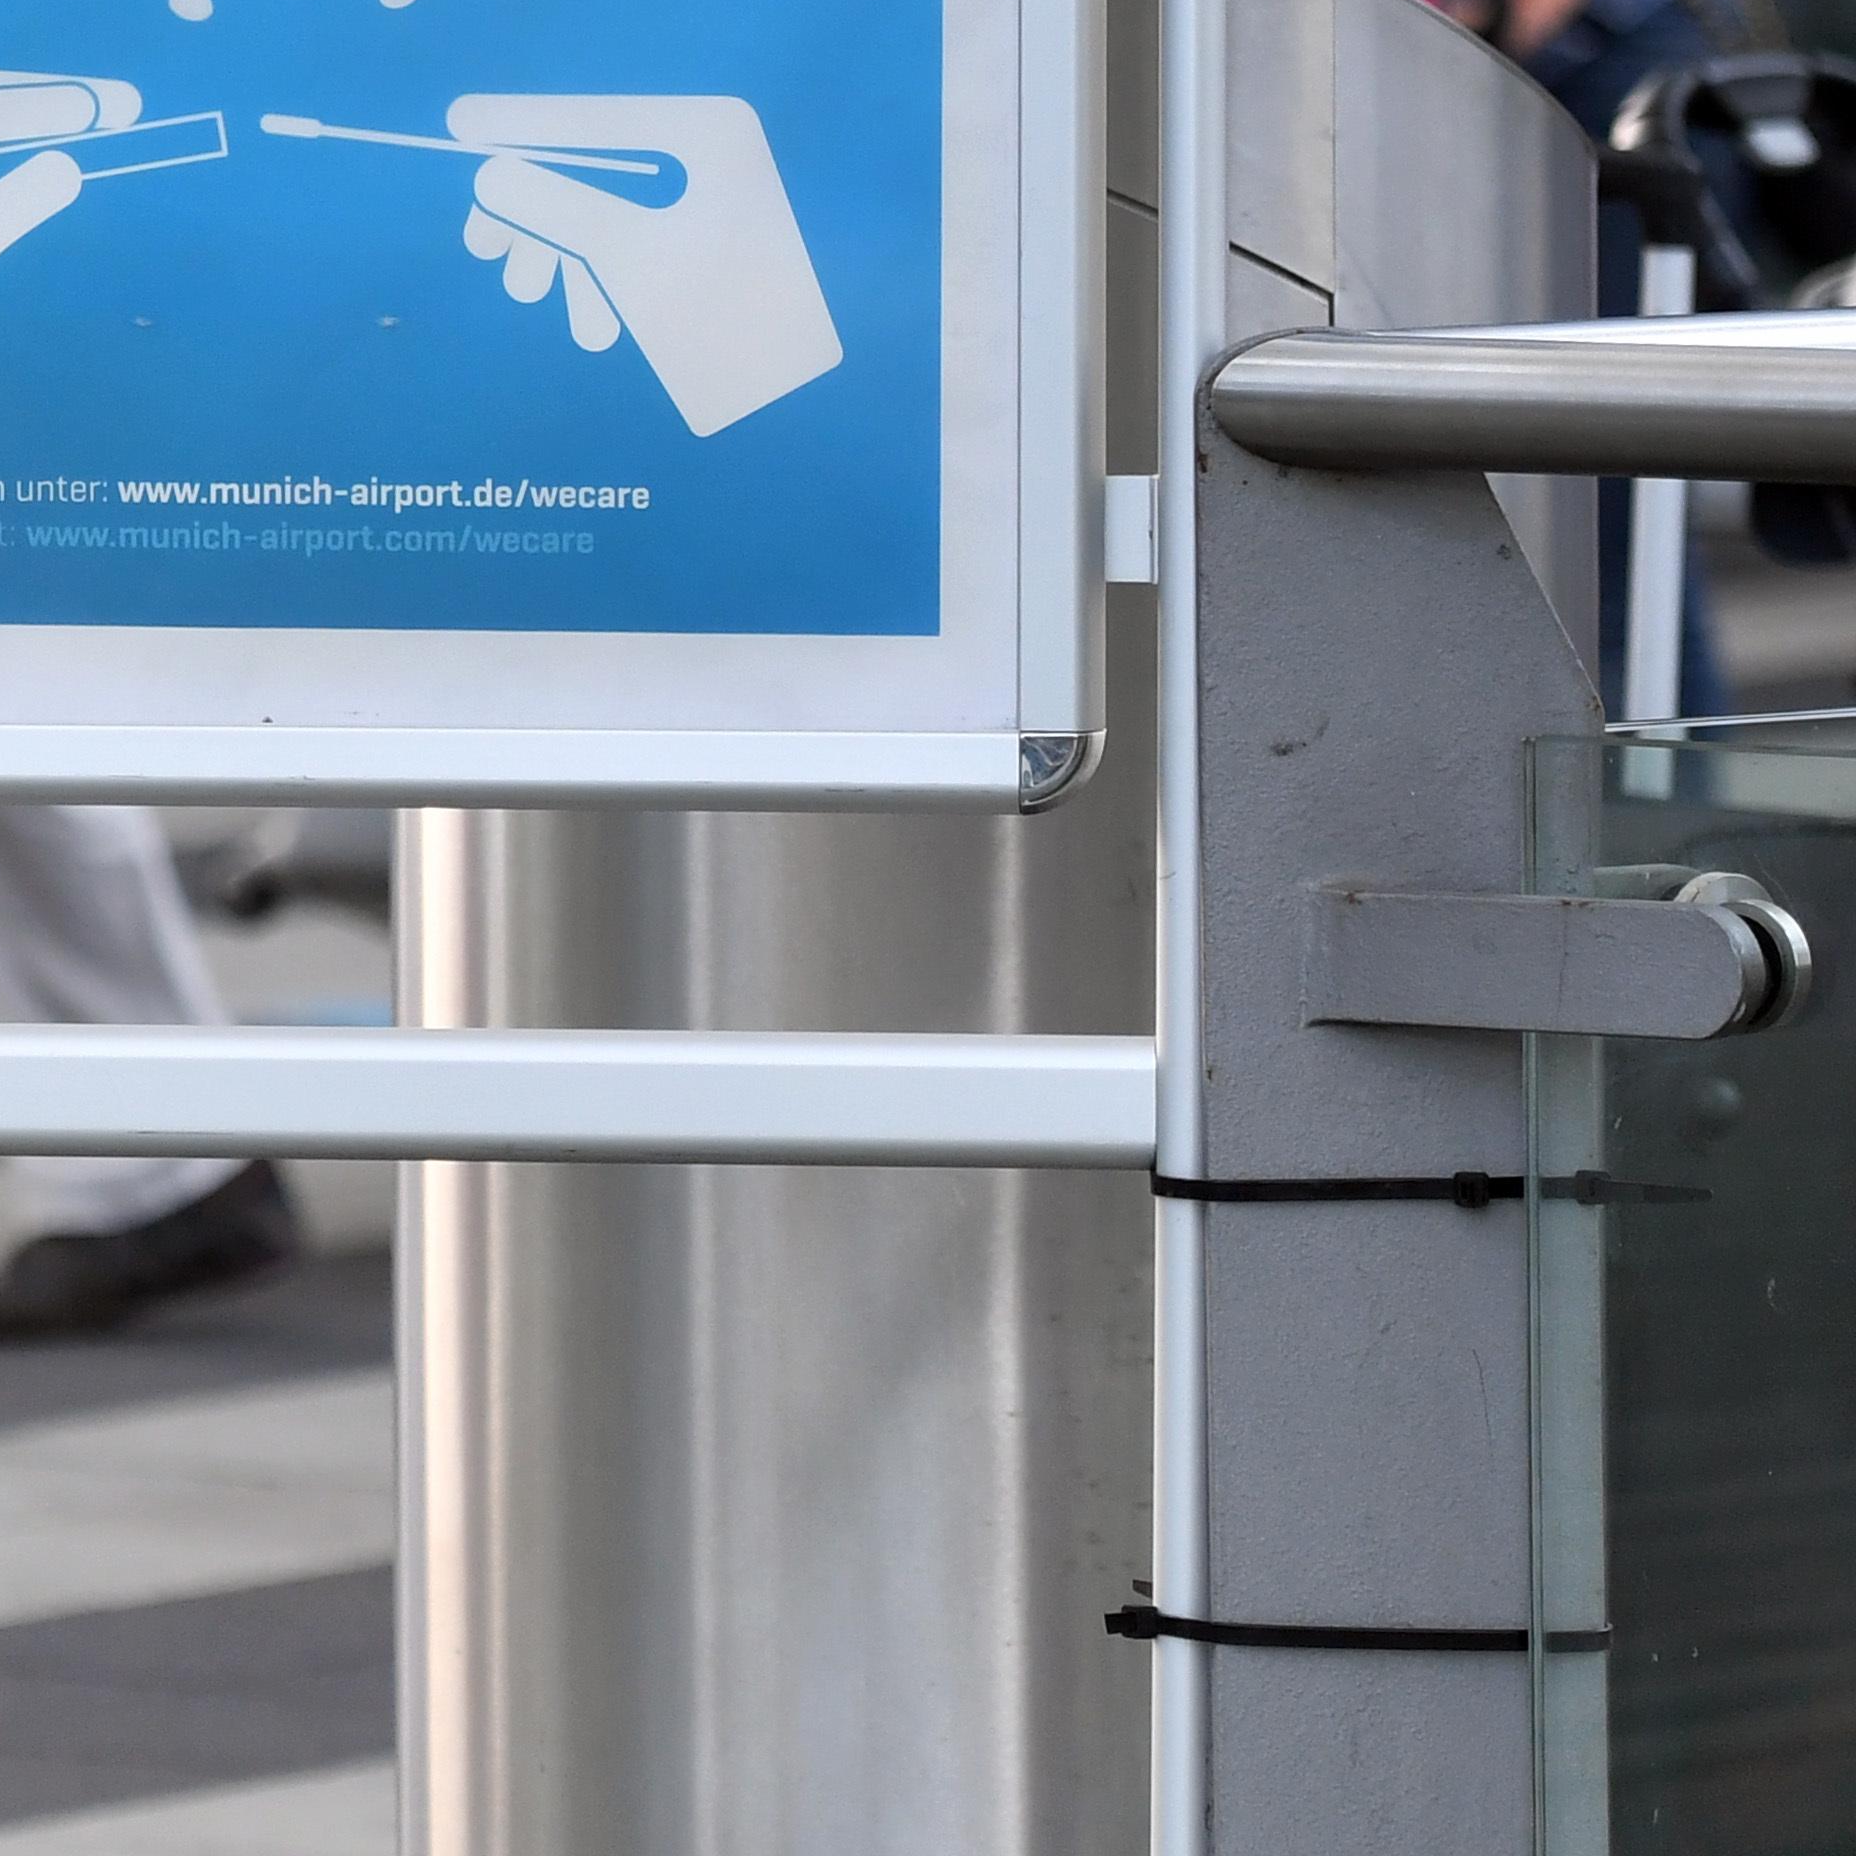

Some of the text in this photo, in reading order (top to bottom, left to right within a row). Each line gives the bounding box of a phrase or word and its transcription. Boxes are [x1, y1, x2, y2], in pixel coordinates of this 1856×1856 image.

[17, 476, 110, 504] unter:
[117, 475, 652, 515] www.munich-airport.de/wecare
[26, 518, 597, 558] www.munich-airport.com/wecare
